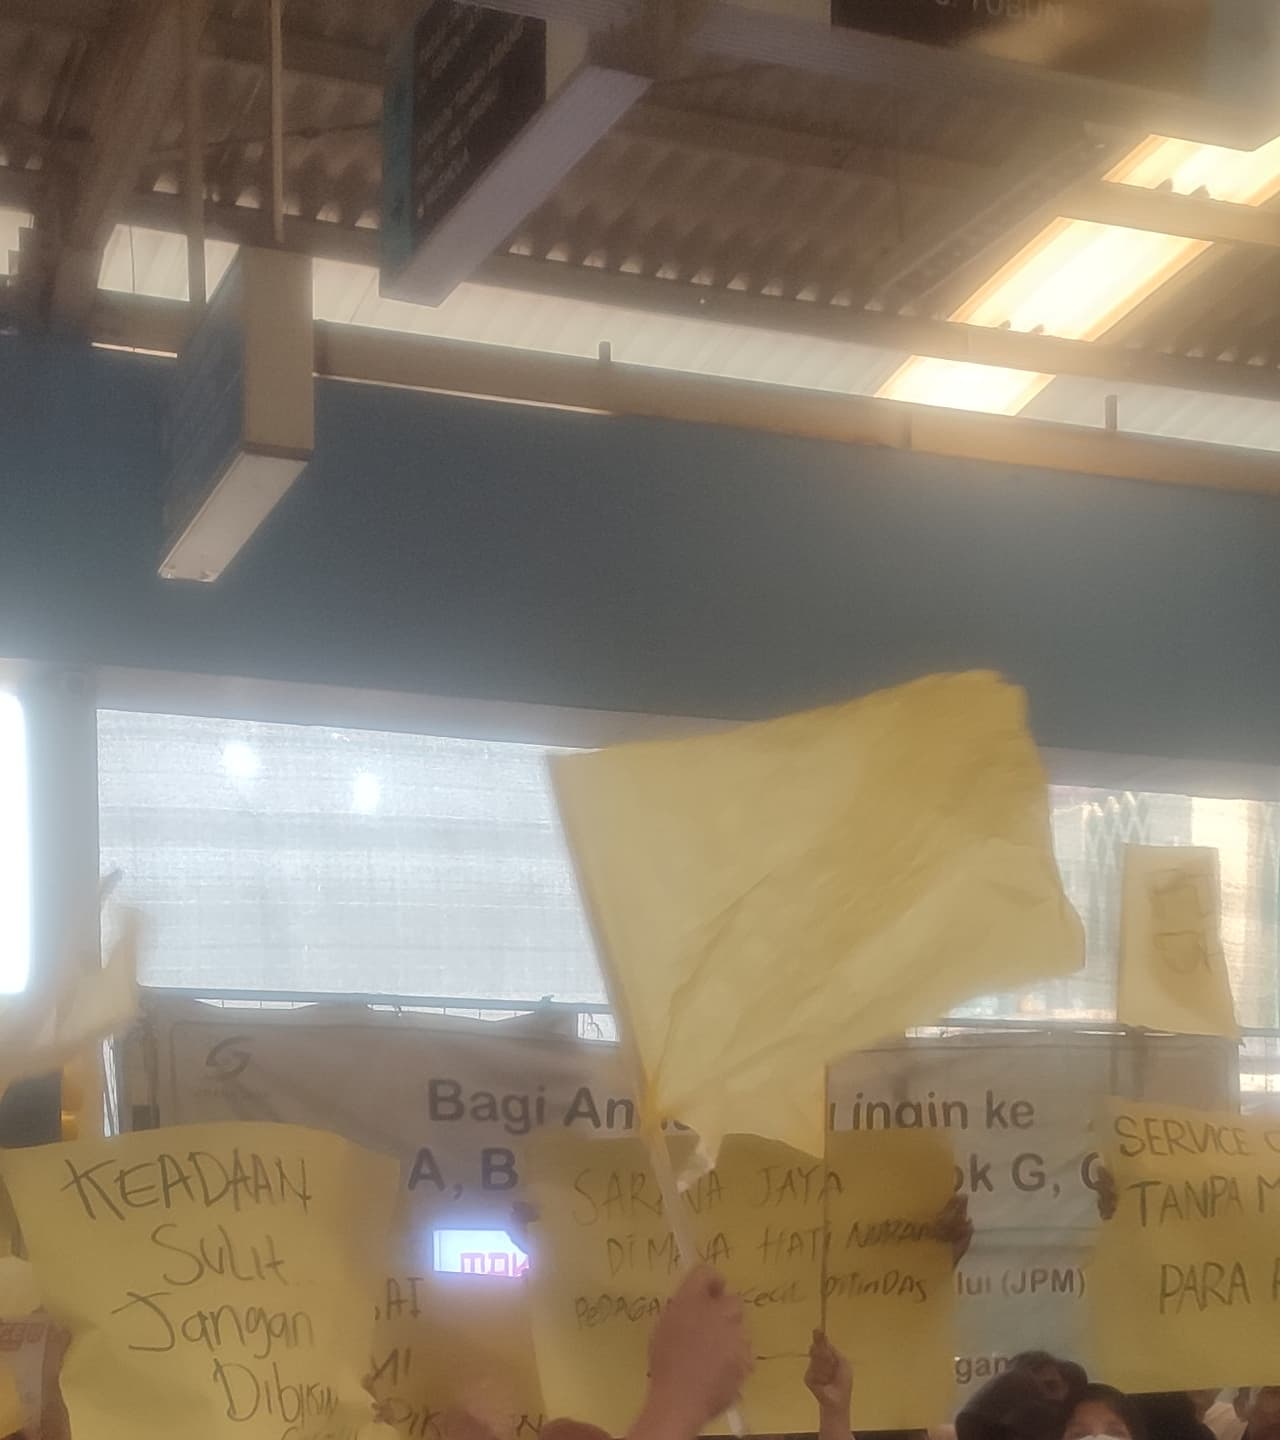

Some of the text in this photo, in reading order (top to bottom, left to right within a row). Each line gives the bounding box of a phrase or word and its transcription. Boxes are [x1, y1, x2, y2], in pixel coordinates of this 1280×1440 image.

[428, 1078, 547, 1135] Bagi
[986, 1090, 1035, 1130] ke
[1114, 1115, 1256, 1159] SERVICE
[61, 1148, 312, 1221] KEADAAN
[1126, 1175, 1243, 1228] TANPA
[1001, 1267, 1087, 1299] (JPM)
[1159, 1260, 1252, 1315] PARA
[111, 1291, 315, 1360] Jangan
